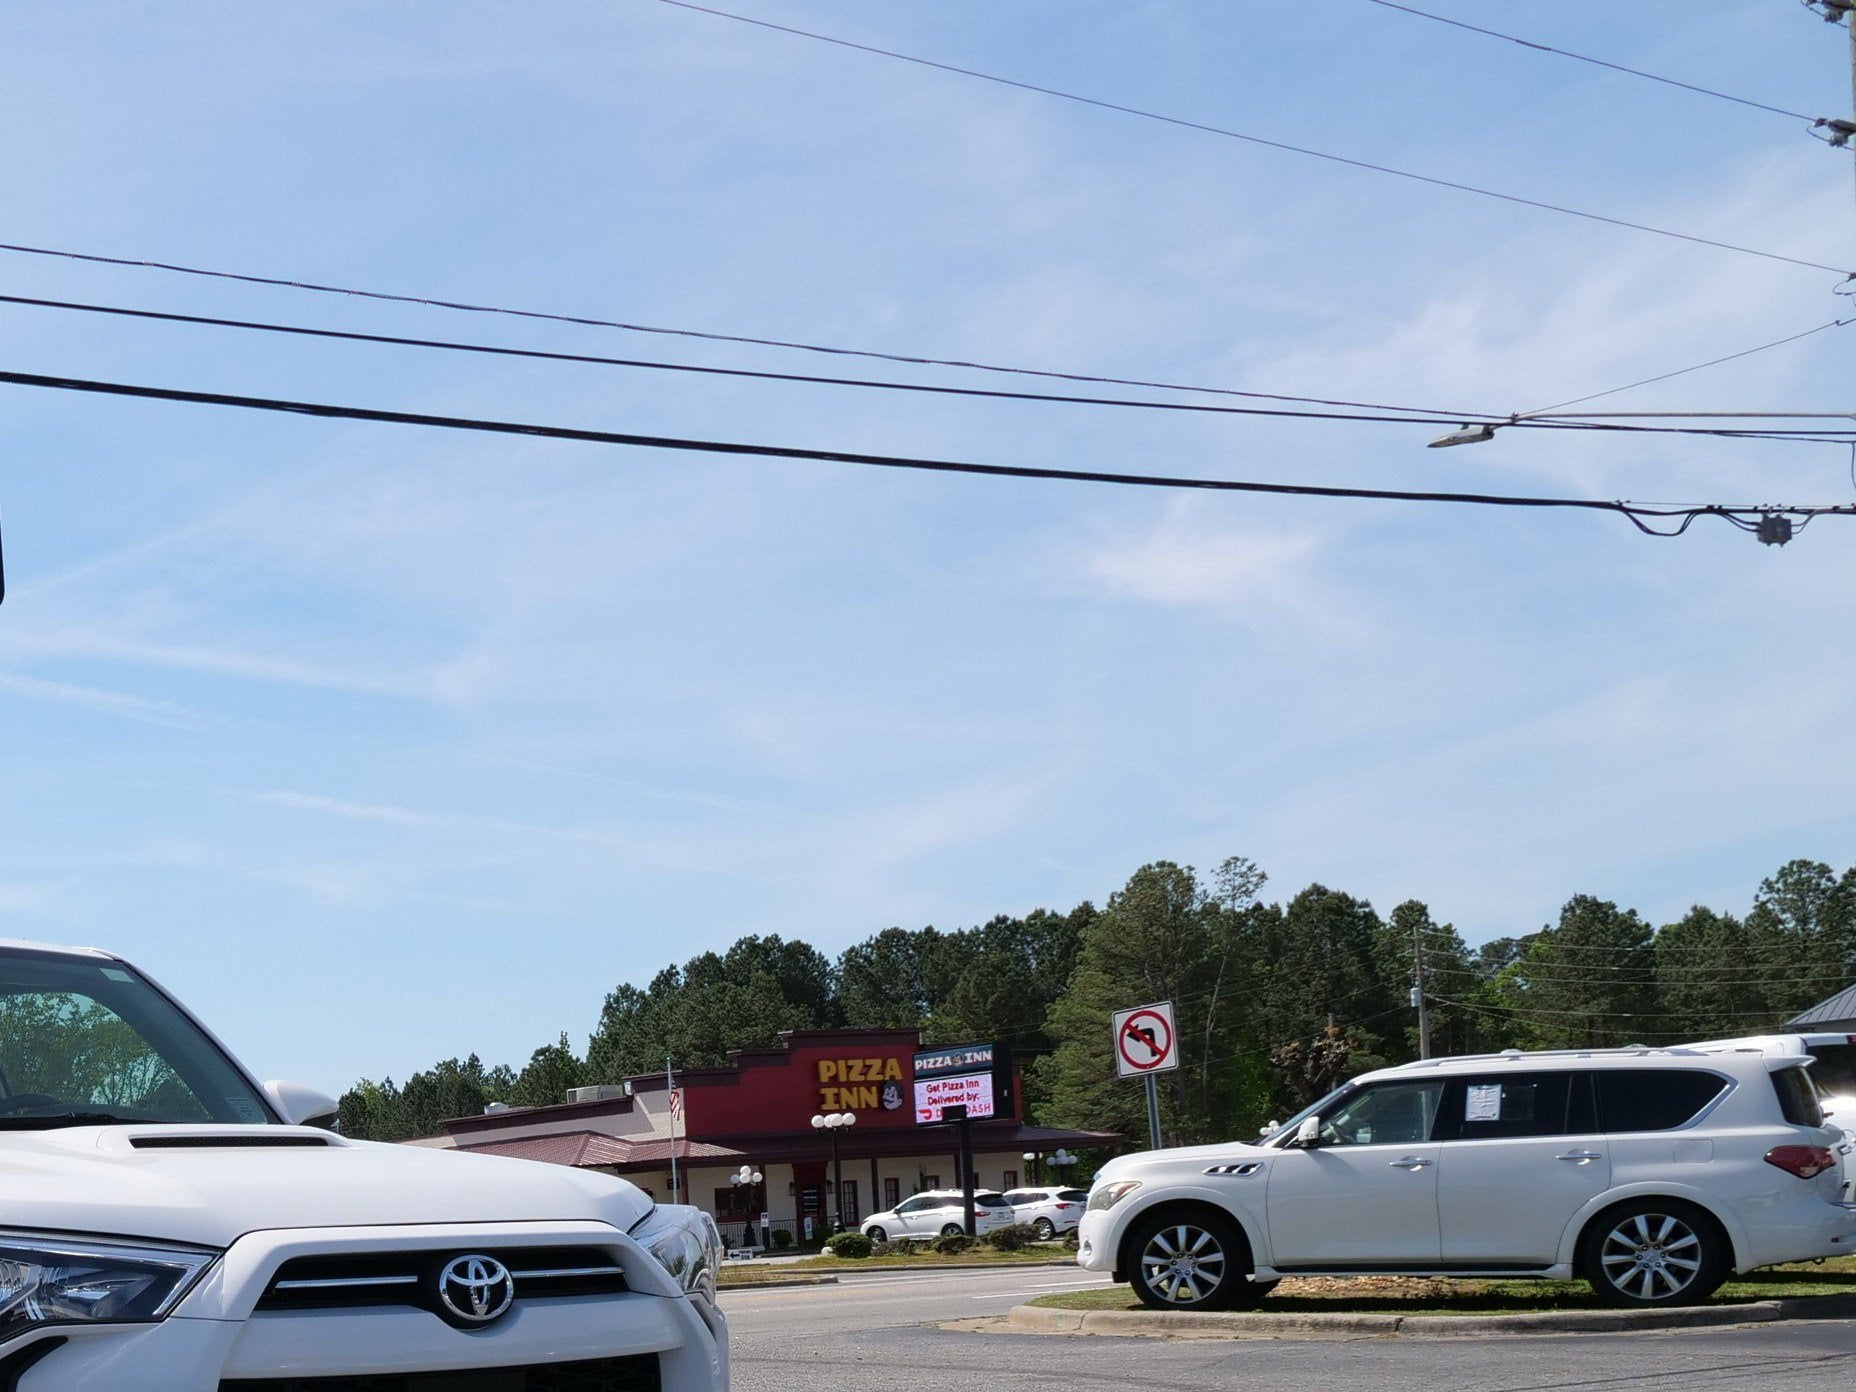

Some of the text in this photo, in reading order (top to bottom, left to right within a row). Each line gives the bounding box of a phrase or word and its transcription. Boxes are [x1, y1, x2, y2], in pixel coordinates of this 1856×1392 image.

[818, 1059, 903, 1083] PIZZA
[914, 1050, 992, 1071] PIZZA INN
[926, 1079, 980, 1093] Get Pizza Inn
[820, 1086, 879, 1111] INN
[927, 1093, 965, 1106] Delivered
